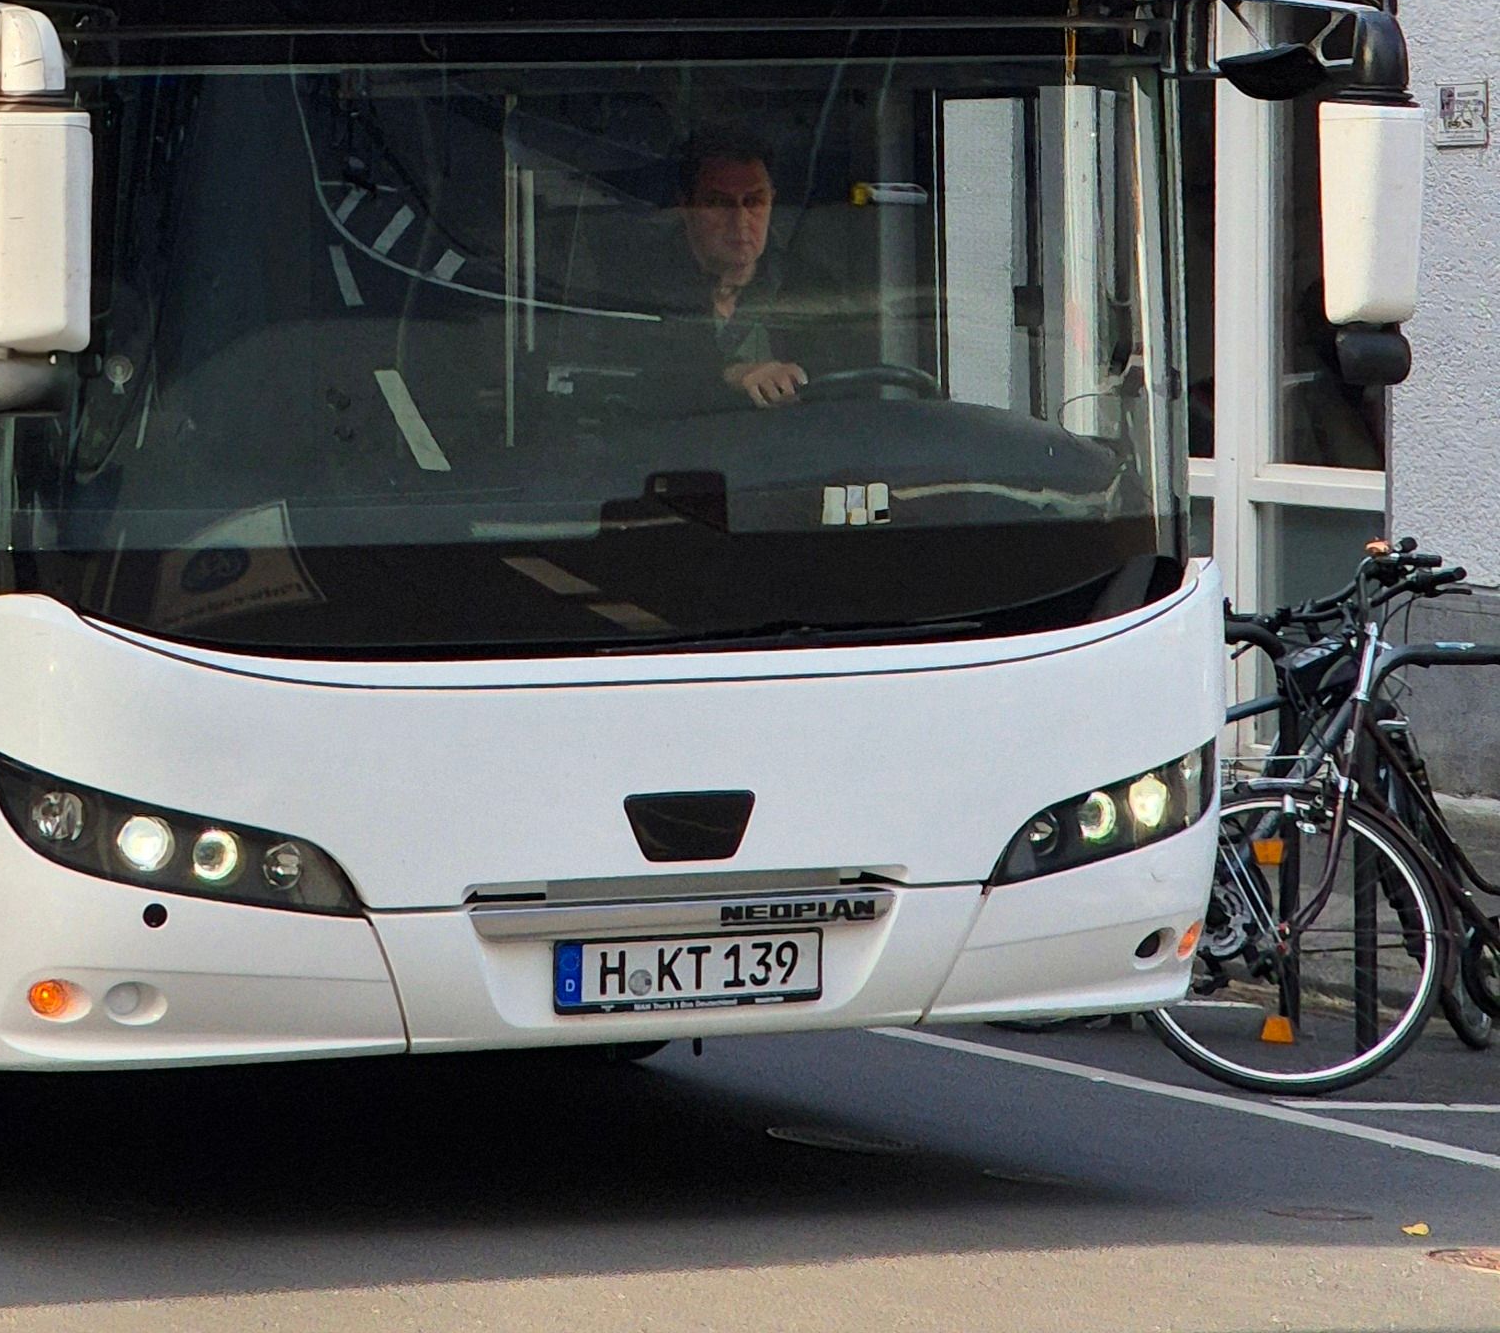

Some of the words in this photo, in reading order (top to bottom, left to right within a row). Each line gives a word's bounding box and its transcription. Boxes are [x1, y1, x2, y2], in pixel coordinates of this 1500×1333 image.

[720, 899, 875, 925] NEOPLAN
[599, 950, 626, 996] H
[657, 945, 711, 992] KT
[723, 941, 799, 989] 139
[565, 982, 575, 993] D
